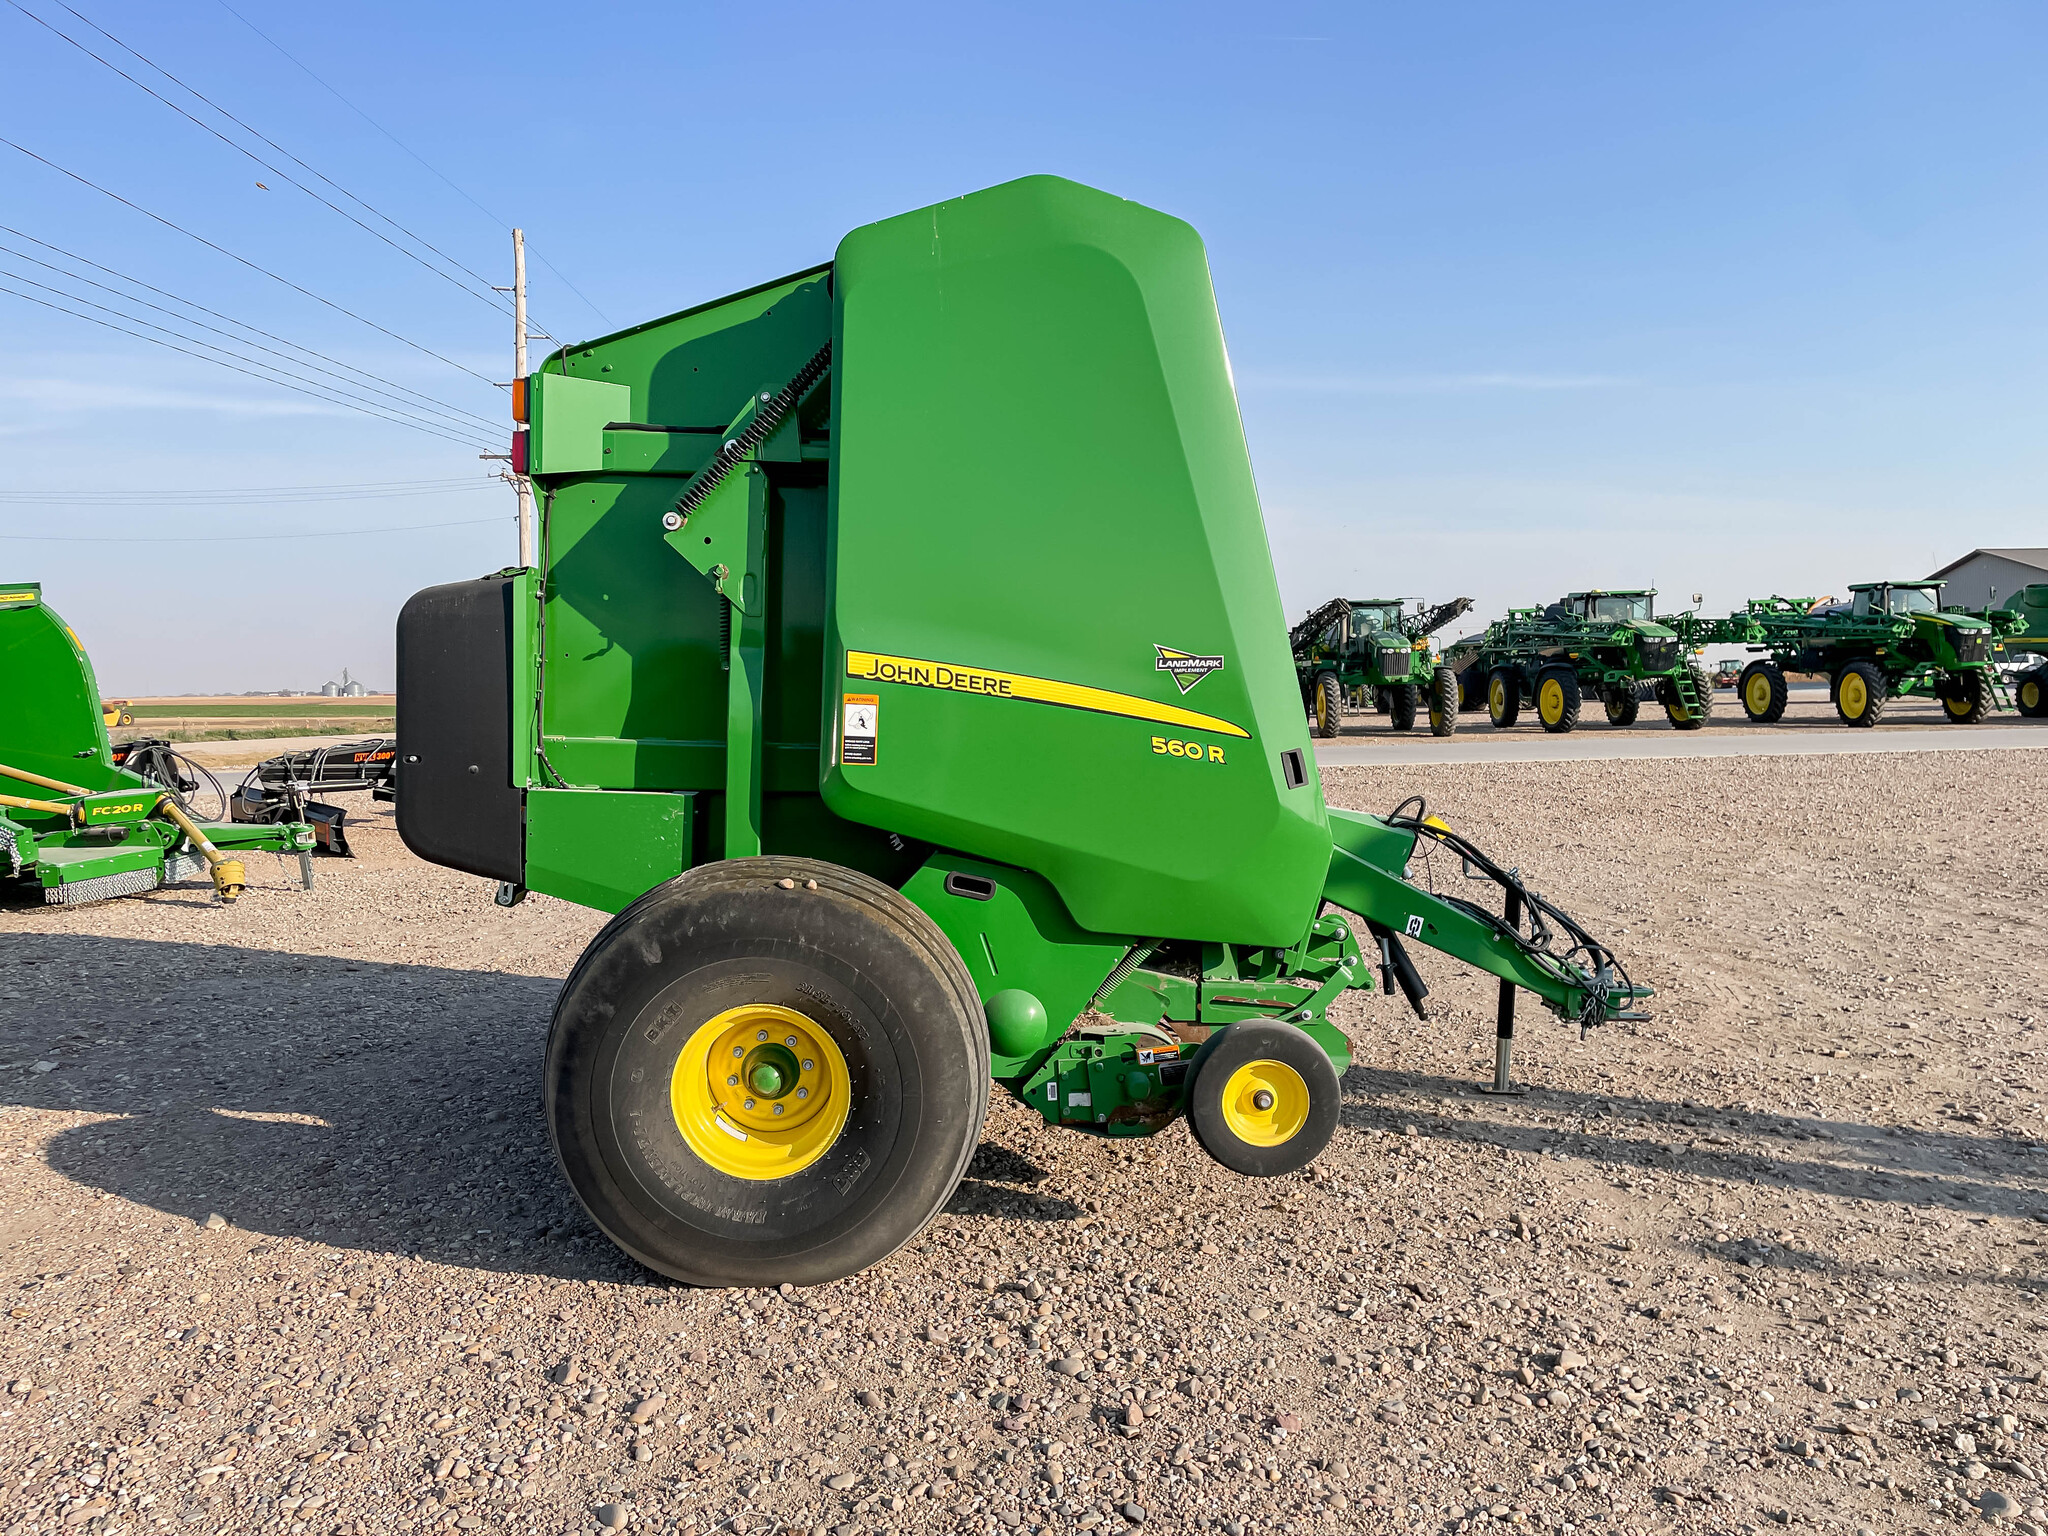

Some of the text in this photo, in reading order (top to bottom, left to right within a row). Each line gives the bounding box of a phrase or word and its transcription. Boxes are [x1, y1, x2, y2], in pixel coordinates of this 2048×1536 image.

[1158, 659, 1222, 668] LANDMARK
[866, 659, 1012, 695] JOHN DEERE
